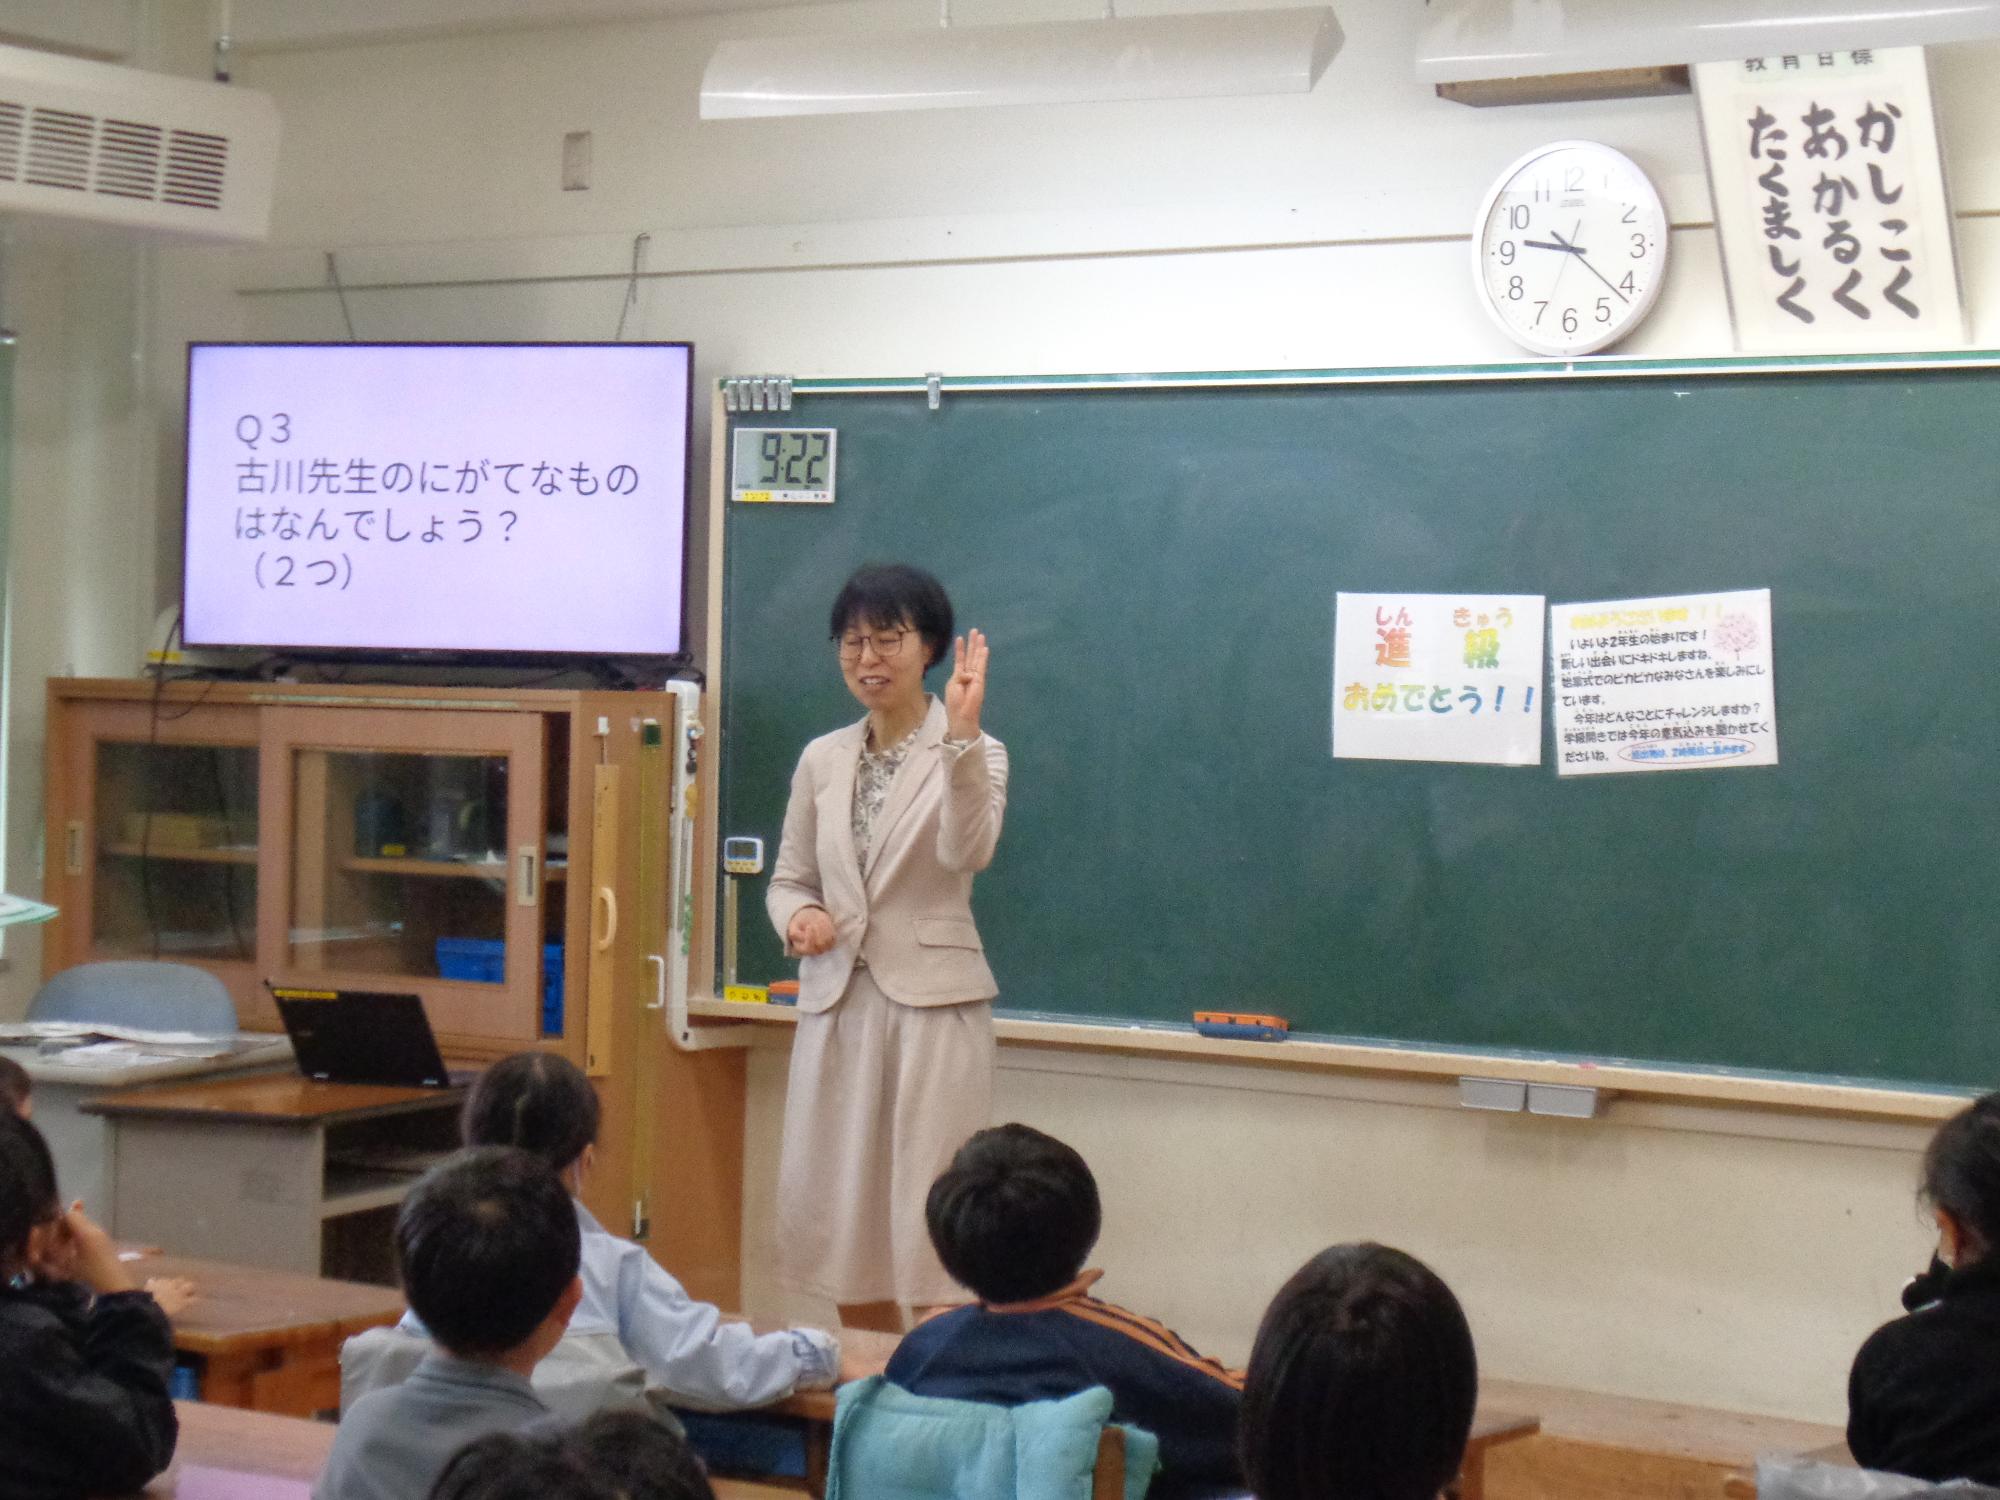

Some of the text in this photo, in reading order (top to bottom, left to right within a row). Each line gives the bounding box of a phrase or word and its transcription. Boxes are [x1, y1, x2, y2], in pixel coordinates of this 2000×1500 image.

[1535, 178, 1550, 203] 11
[1564, 167, 1585, 193] 12
[1510, 204, 1530, 230] 10
[1747, 105, 1816, 324] たくましく
[1801, 100, 1871, 320] あかるく
[1855, 100, 1920, 320] かしこく
[1500, 240, 1516, 266] 9
[1630, 233, 1646, 259] 3
[1508, 275, 1524, 301] 8
[1619, 269, 1636, 295] 4
[1533, 301, 1549, 326] 7
[1562, 307, 1578, 333] 6
[1595, 297, 1611, 322] 5
[760, 433, 830, 484] 9:22
[236, 457, 639, 497] 古川先生のにがてなもの
[235, 508, 518, 543] はなんでしょう？
[1376, 606, 1513, 628] しん きゅう
[1343, 682, 1534, 714] おめでとう！！
